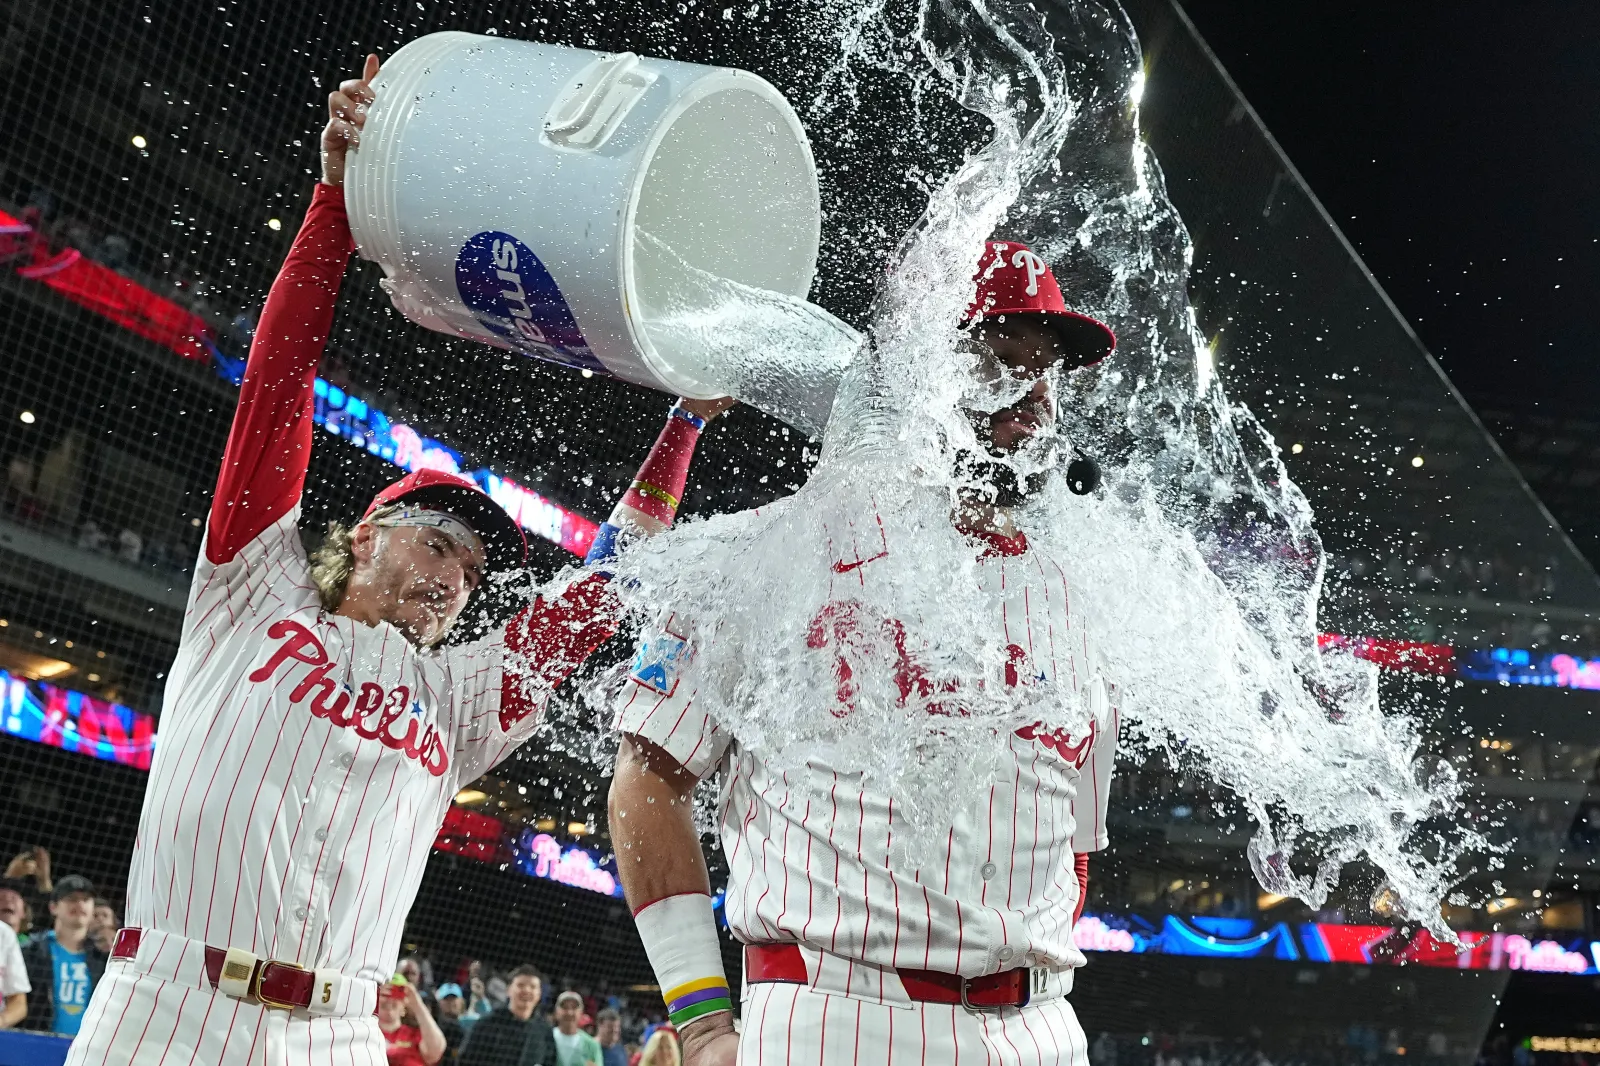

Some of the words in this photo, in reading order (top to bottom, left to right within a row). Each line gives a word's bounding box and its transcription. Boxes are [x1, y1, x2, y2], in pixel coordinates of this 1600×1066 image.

[1012, 249, 1046, 297] P
[249, 619, 449, 777] Phillies
[321, 982, 333, 1004] 5
[1033, 967, 1048, 995] 12
